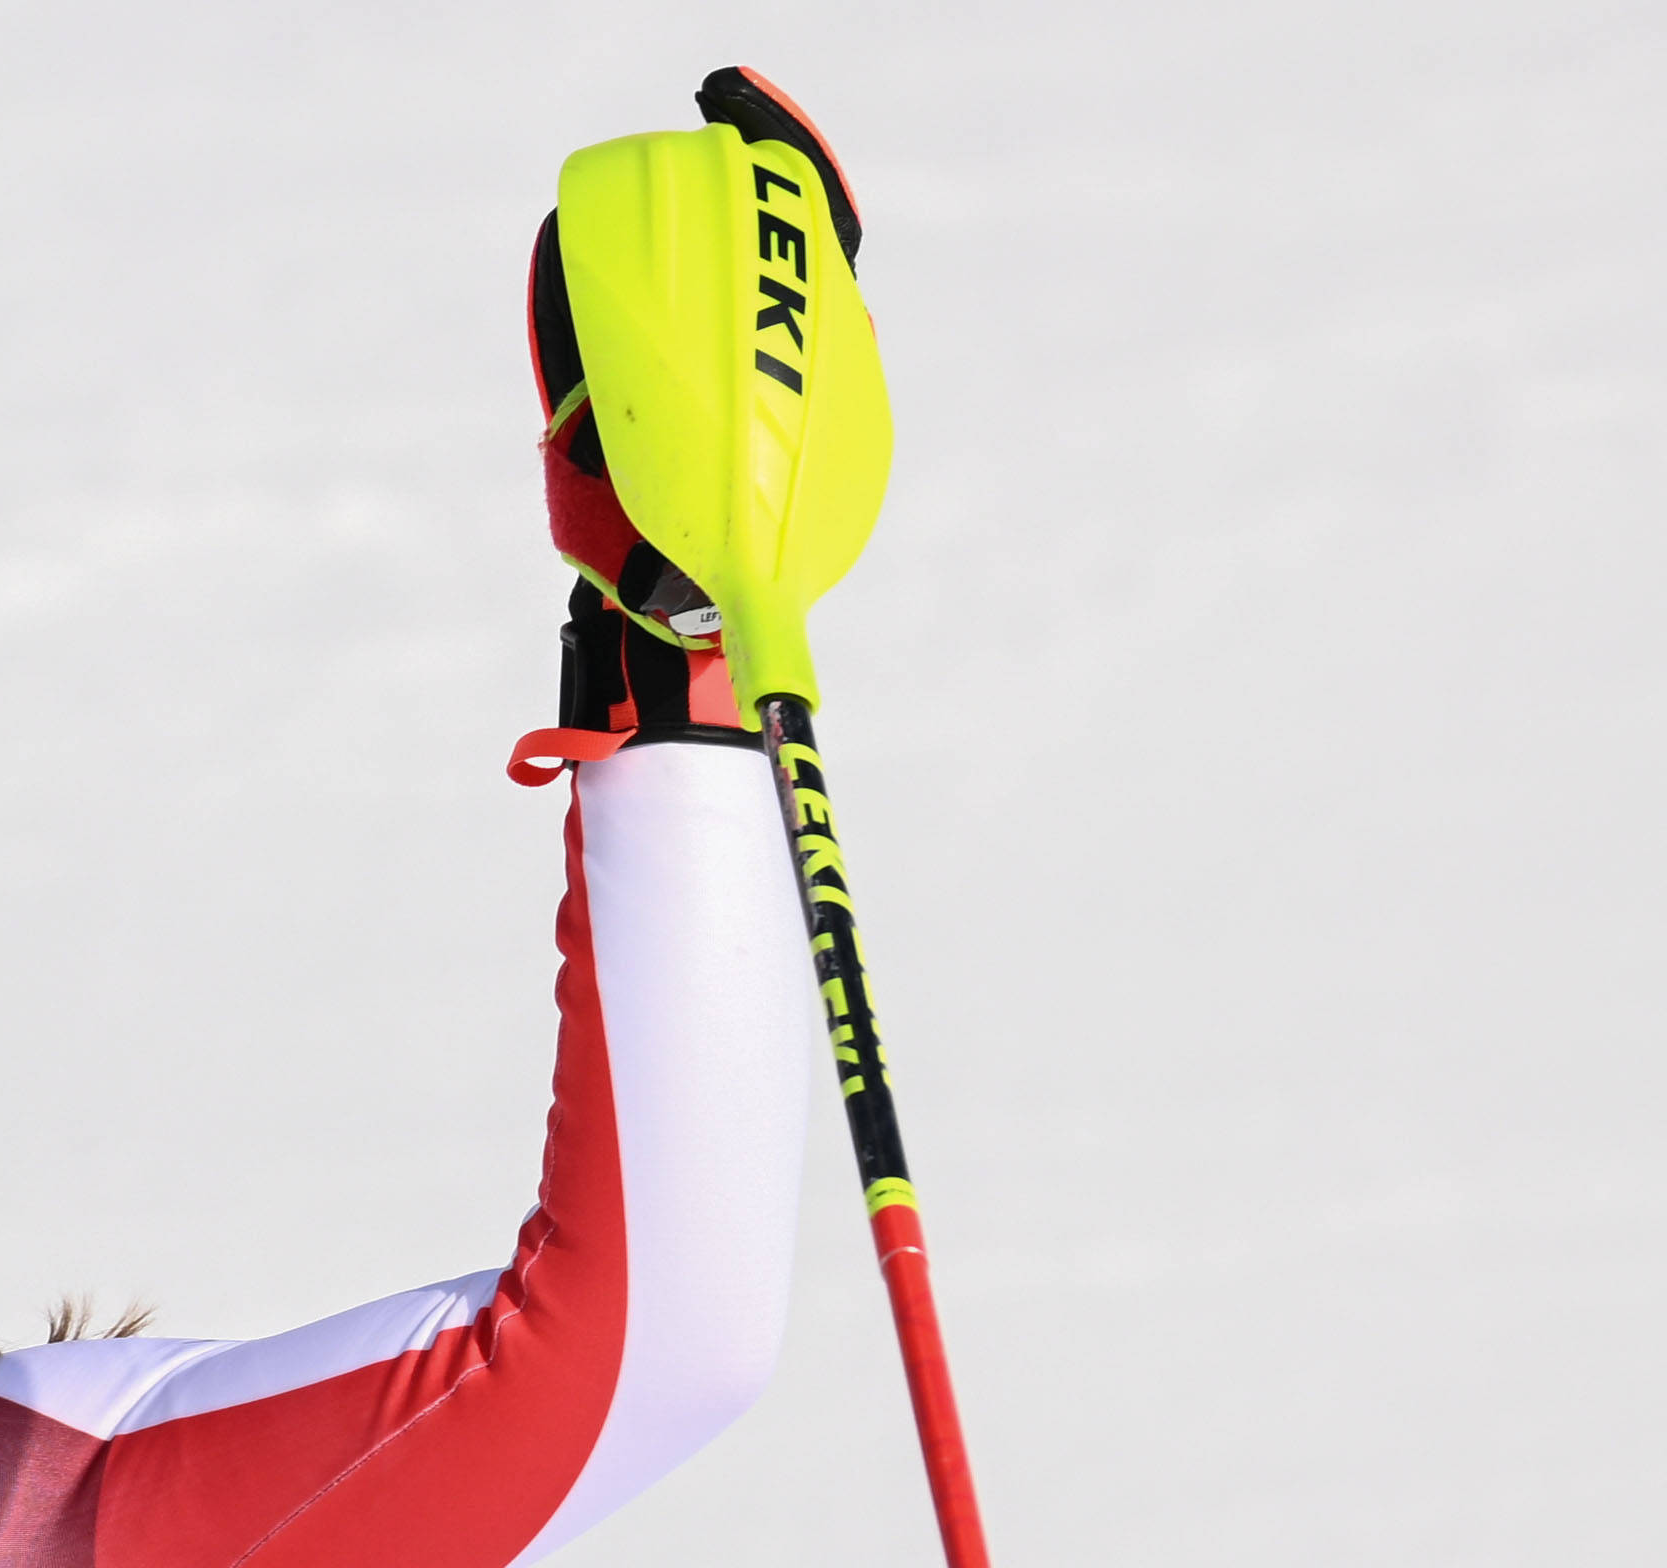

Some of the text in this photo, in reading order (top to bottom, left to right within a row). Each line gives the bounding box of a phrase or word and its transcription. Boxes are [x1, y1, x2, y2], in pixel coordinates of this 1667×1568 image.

[753, 162, 807, 396] LEKI
[700, 610, 722, 623] LEF
[778, 742, 855, 916] LEKI
